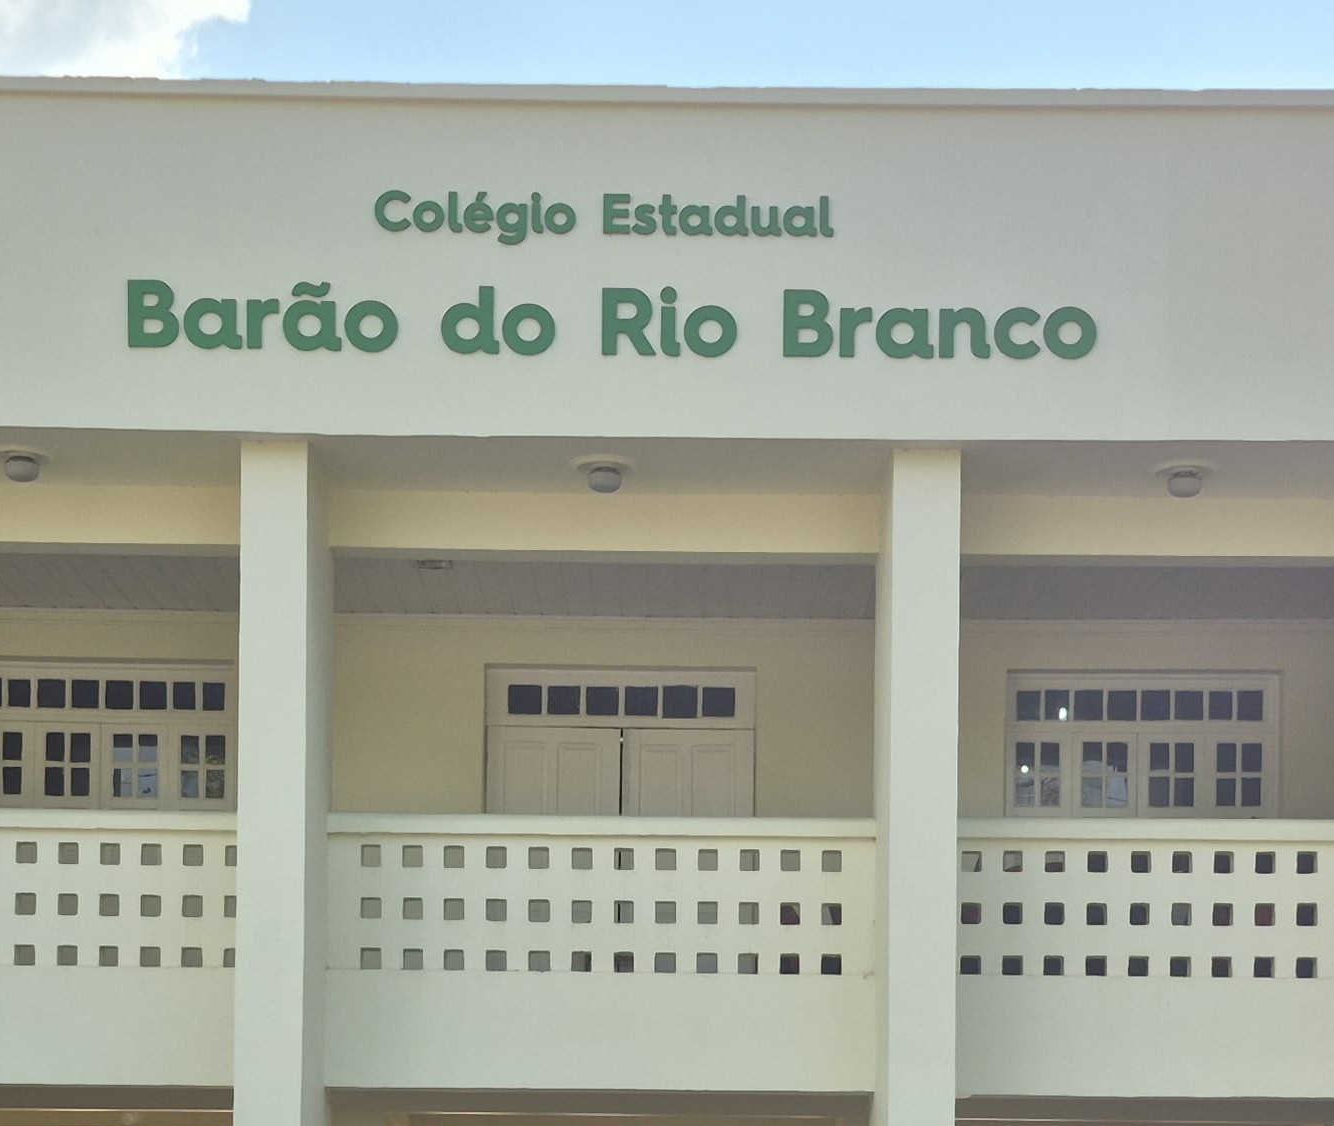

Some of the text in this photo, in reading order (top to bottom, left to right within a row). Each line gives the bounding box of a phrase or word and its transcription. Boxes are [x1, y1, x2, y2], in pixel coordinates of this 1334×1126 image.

[373, 189, 835, 245] Colégio Estadual
[127, 280, 1098, 360] Barão do Rio Branco
